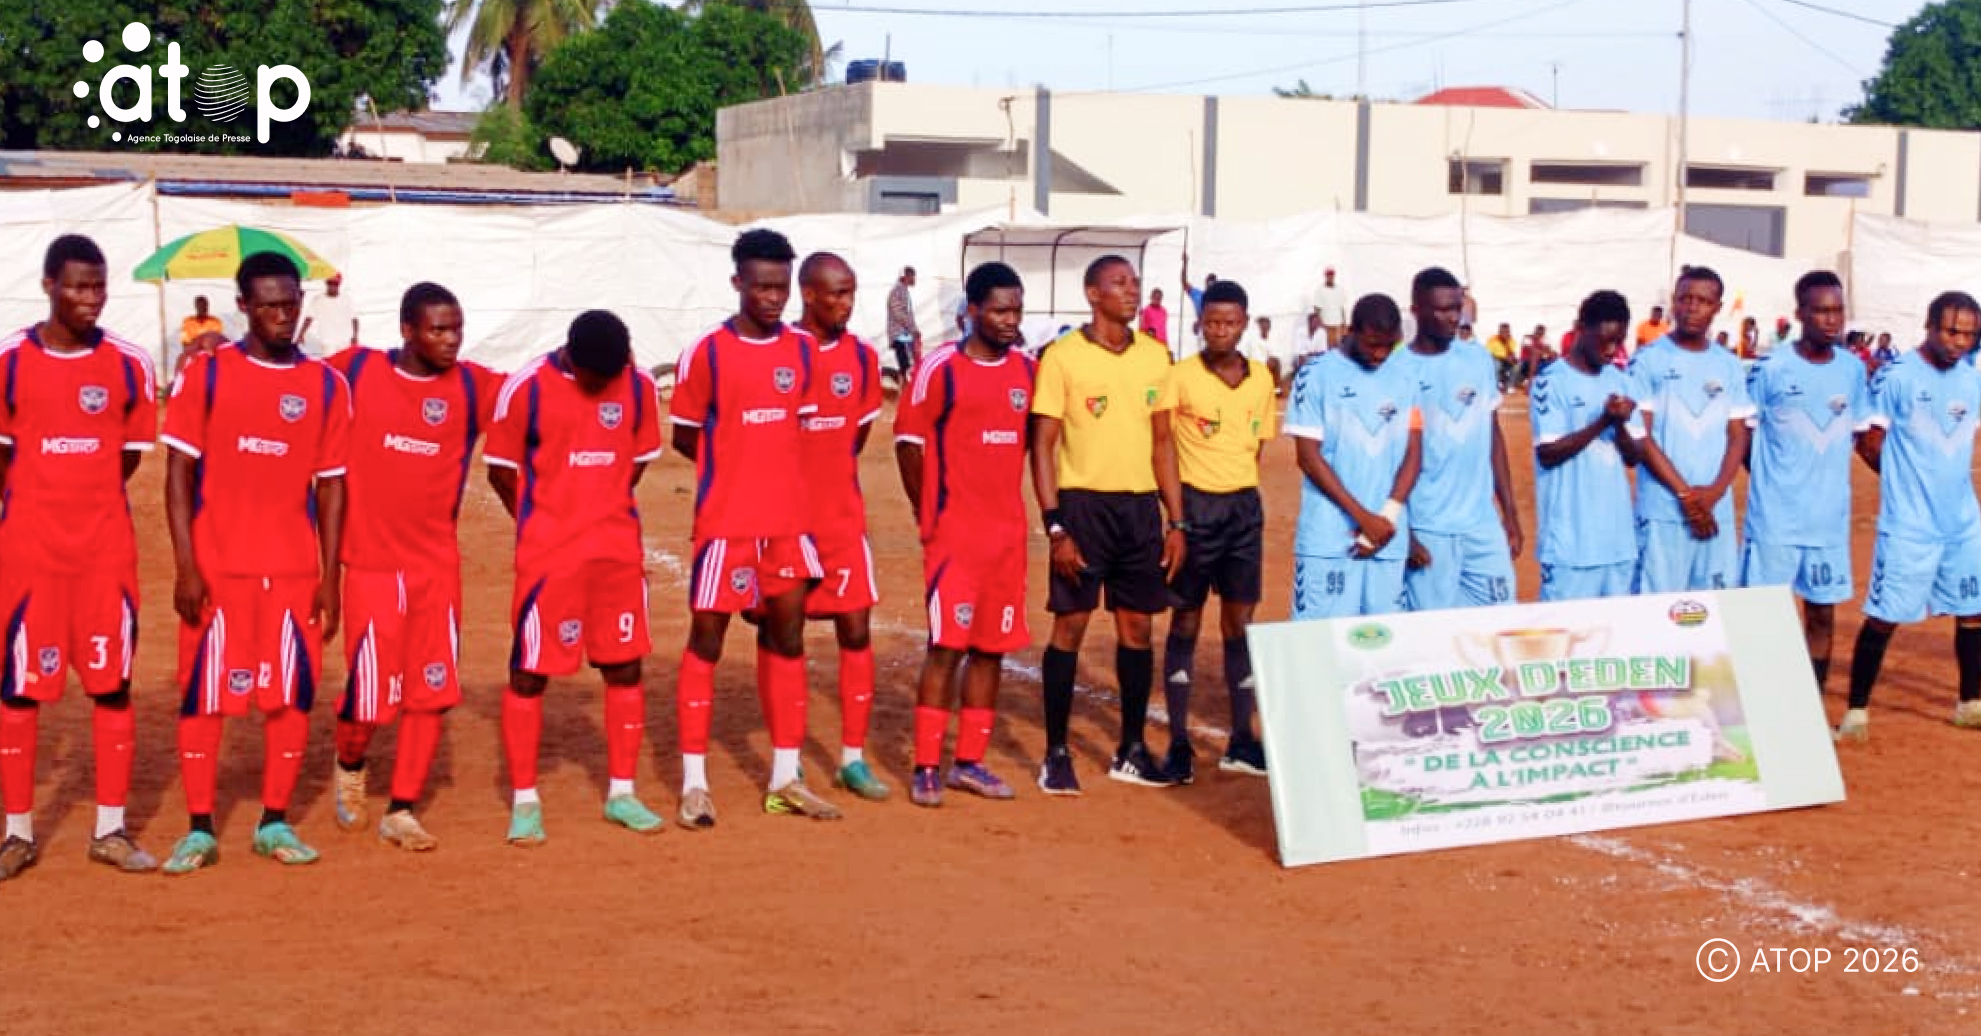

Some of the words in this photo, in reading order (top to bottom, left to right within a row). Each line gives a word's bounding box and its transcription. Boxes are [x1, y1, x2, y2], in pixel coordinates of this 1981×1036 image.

[837, 568, 851, 597] 7
[1810, 563, 1831, 586] 10
[619, 612, 634, 642] 9
[1001, 605, 1014, 633] 8
[89, 635, 109, 669] 3
[1376, 667, 1506, 713] JEUX
[1518, 656, 1688, 693] D'EDEN
[1479, 697, 1611, 741] 2026
[1424, 754, 1460, 772] DE
[1469, 750, 1500, 768] LA
[1510, 731, 1690, 761] CONSCIENCE
[1497, 758, 1620, 787] L'IMPACT
